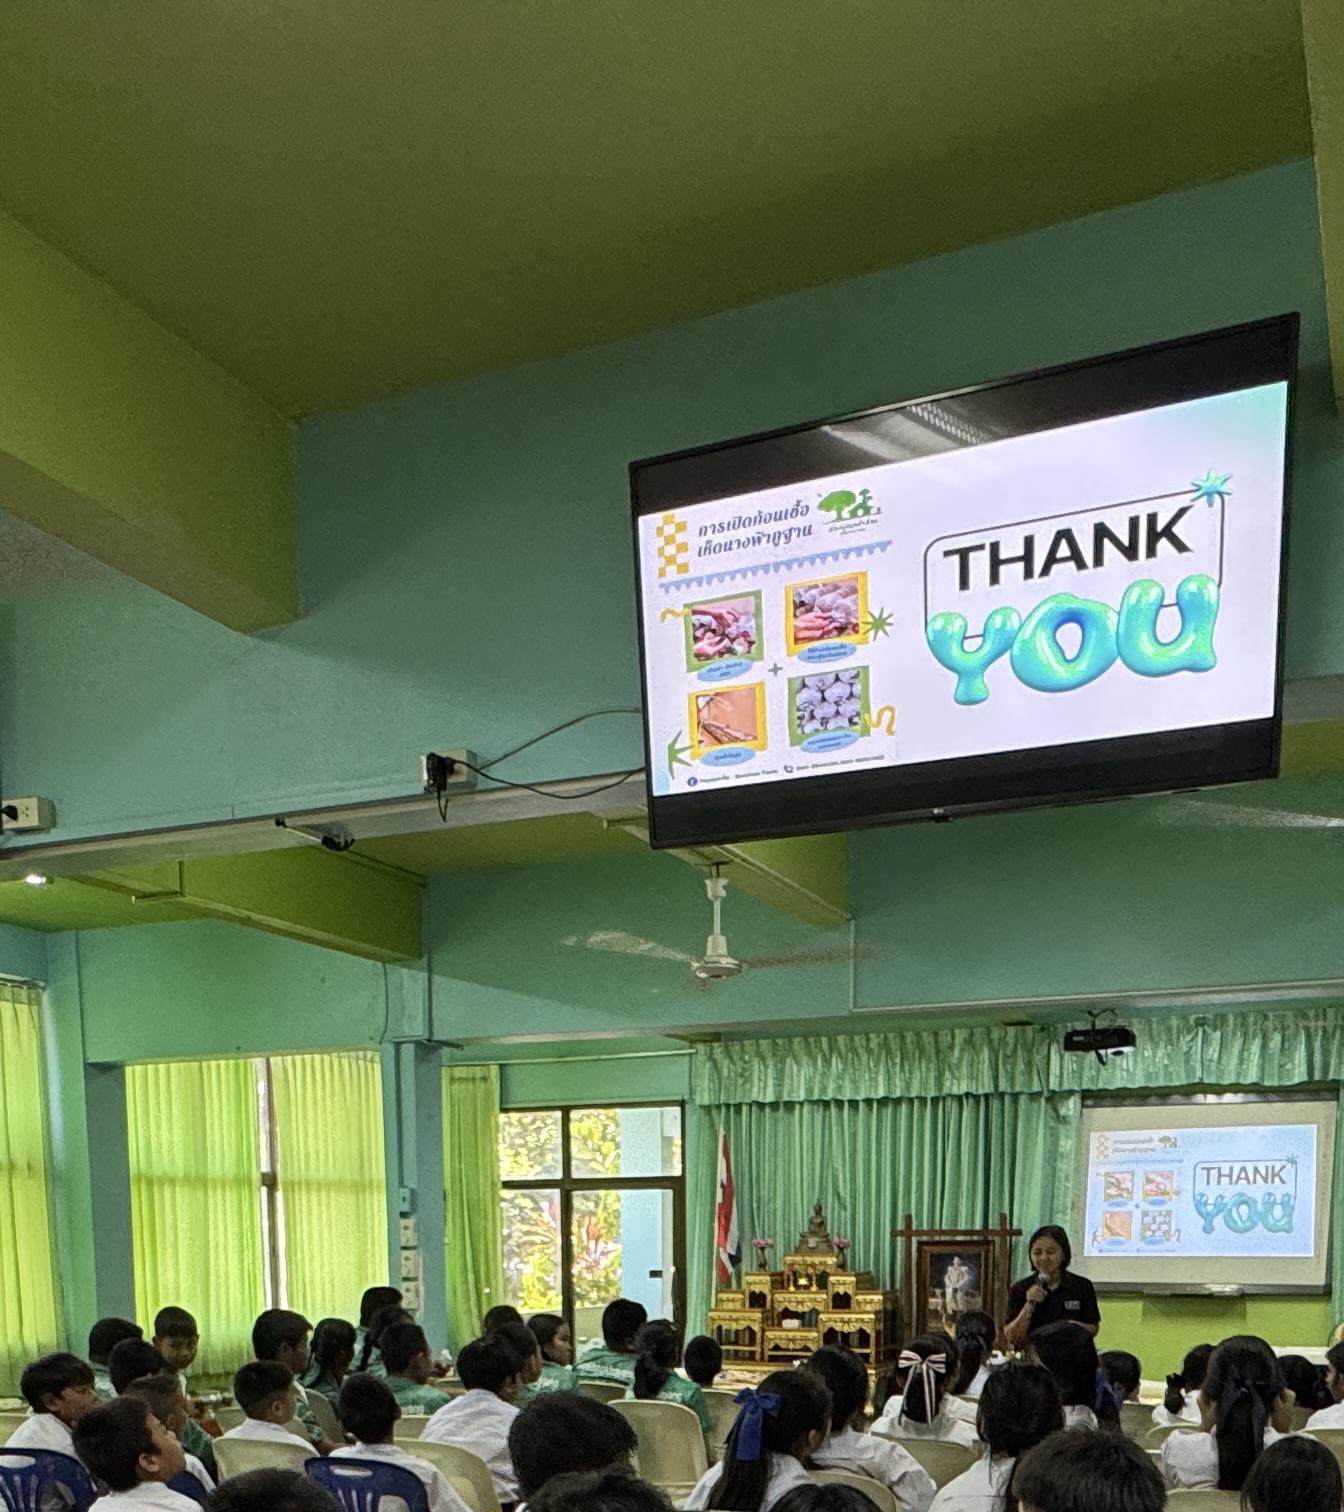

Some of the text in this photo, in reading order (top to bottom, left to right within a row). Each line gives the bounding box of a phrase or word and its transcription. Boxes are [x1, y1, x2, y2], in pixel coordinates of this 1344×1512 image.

[698, 499, 810, 537] การเปิดก้อนเชื้อ
[943, 505, 1194, 591] THANK
[926, 573, 1220, 706] YOU
[1201, 1164, 1287, 1186] THANK
[1193, 1192, 1293, 1234] YOU
